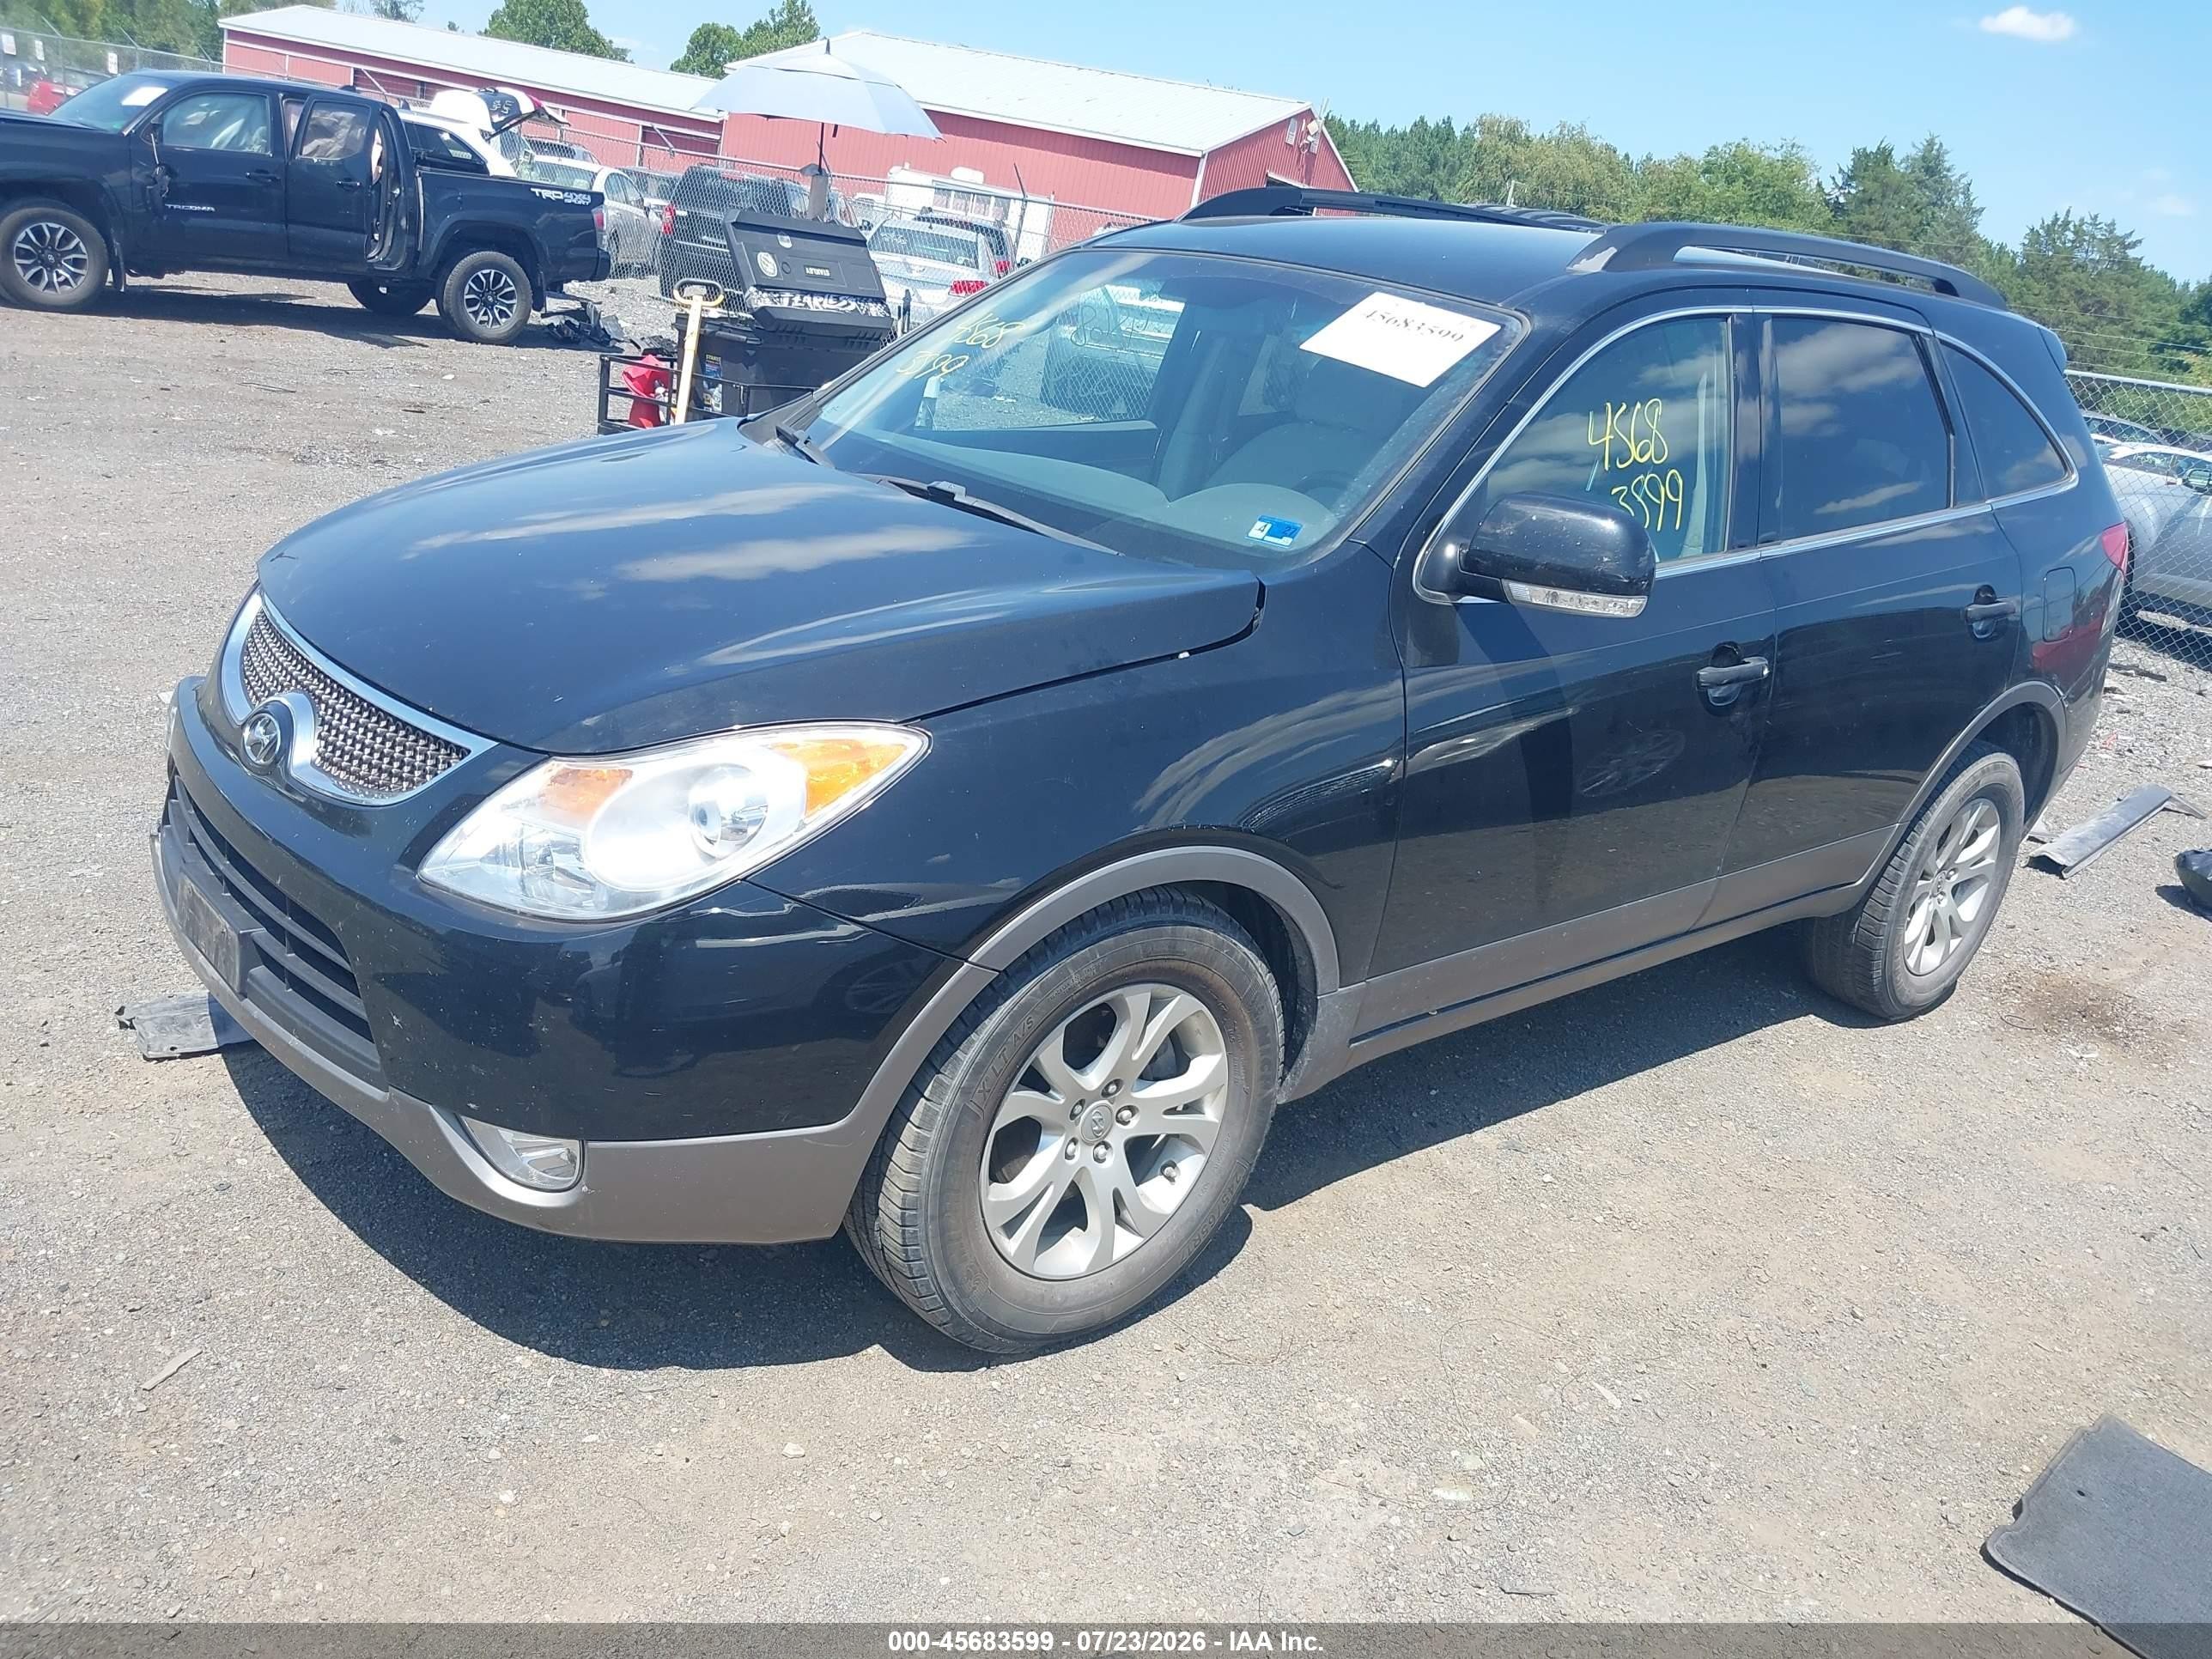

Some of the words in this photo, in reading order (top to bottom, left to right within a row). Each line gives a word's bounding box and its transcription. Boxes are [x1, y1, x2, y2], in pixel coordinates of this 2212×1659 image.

[530, 187, 564, 201] TRD
[1589, 398, 1668, 471] 4568
[1610, 469, 1683, 532] 3599
